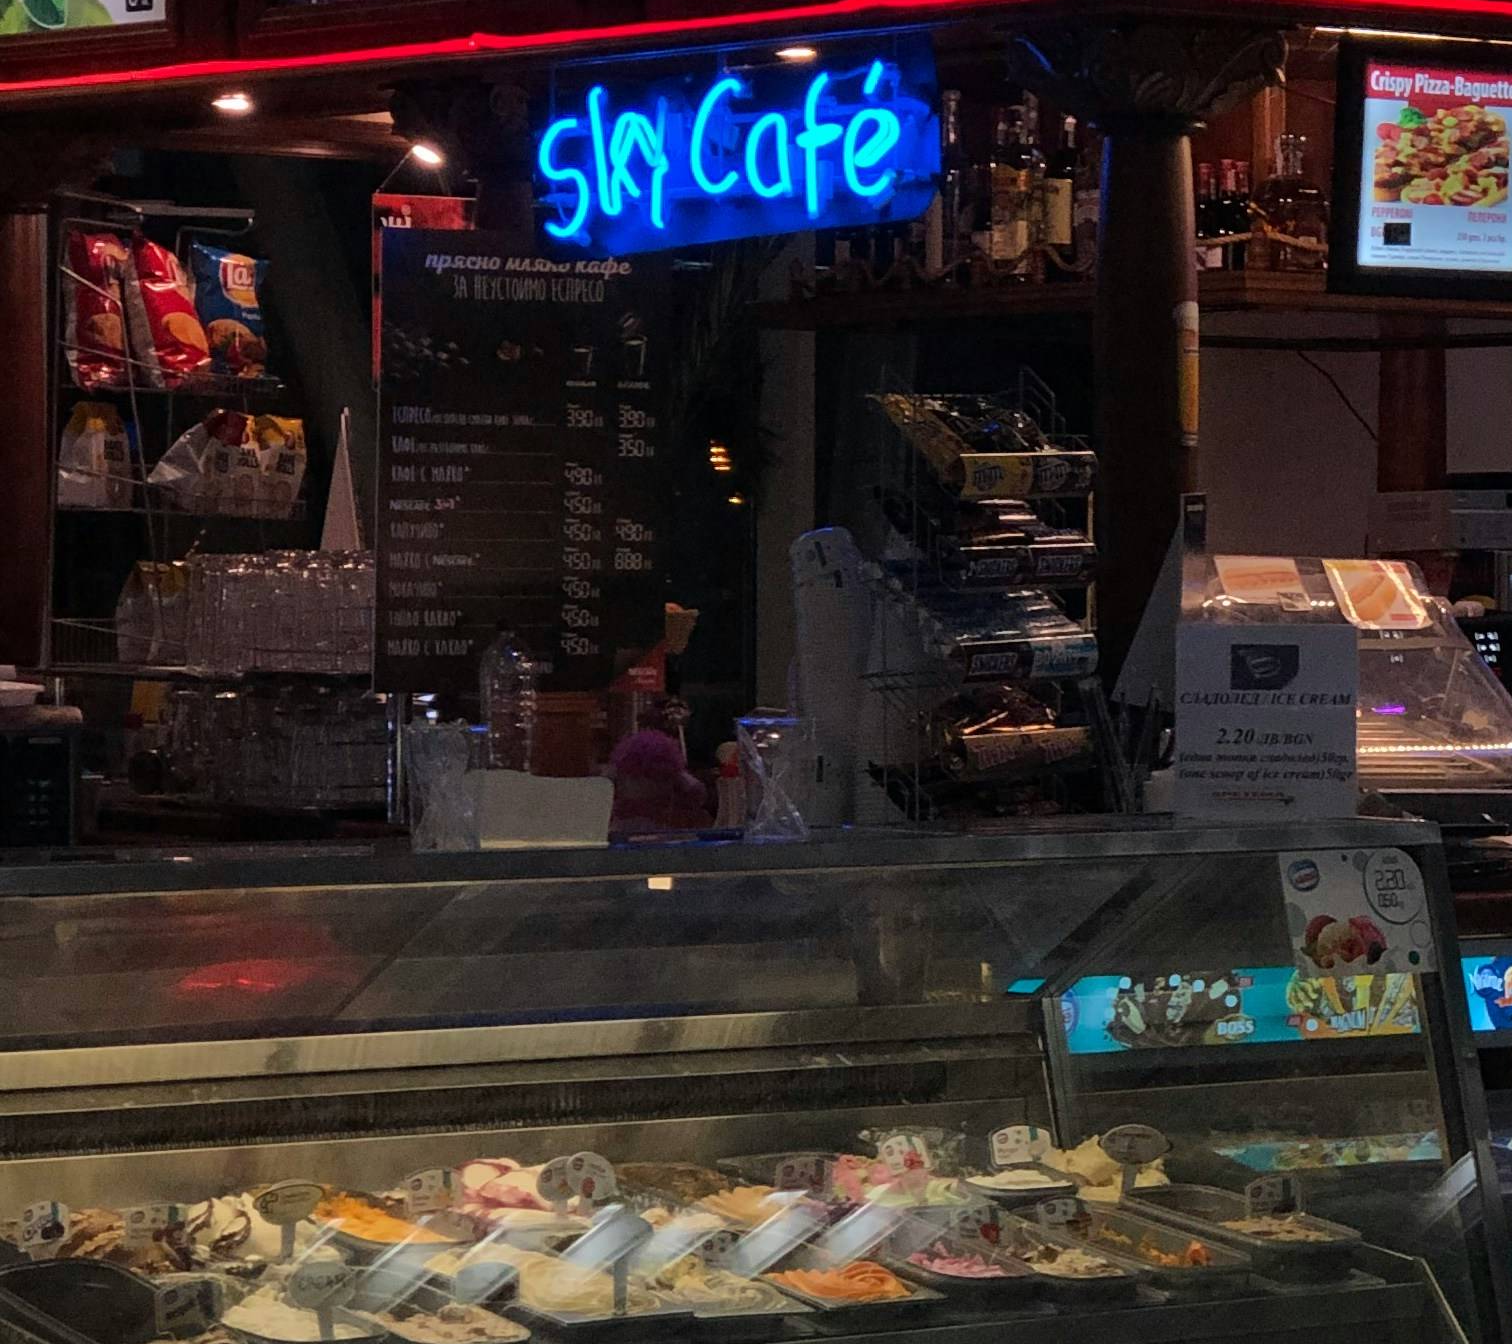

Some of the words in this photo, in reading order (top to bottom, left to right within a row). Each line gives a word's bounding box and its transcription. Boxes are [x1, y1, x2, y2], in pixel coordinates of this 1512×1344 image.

[1370, 70, 1412, 95] Crispy
[690, 59, 903, 222] Café
[574, 258, 633, 280] кафе
[1271, 693, 1297, 706] ICE
[1300, 693, 1352, 706] CREAM
[1216, 727, 1257, 746] 2.20
